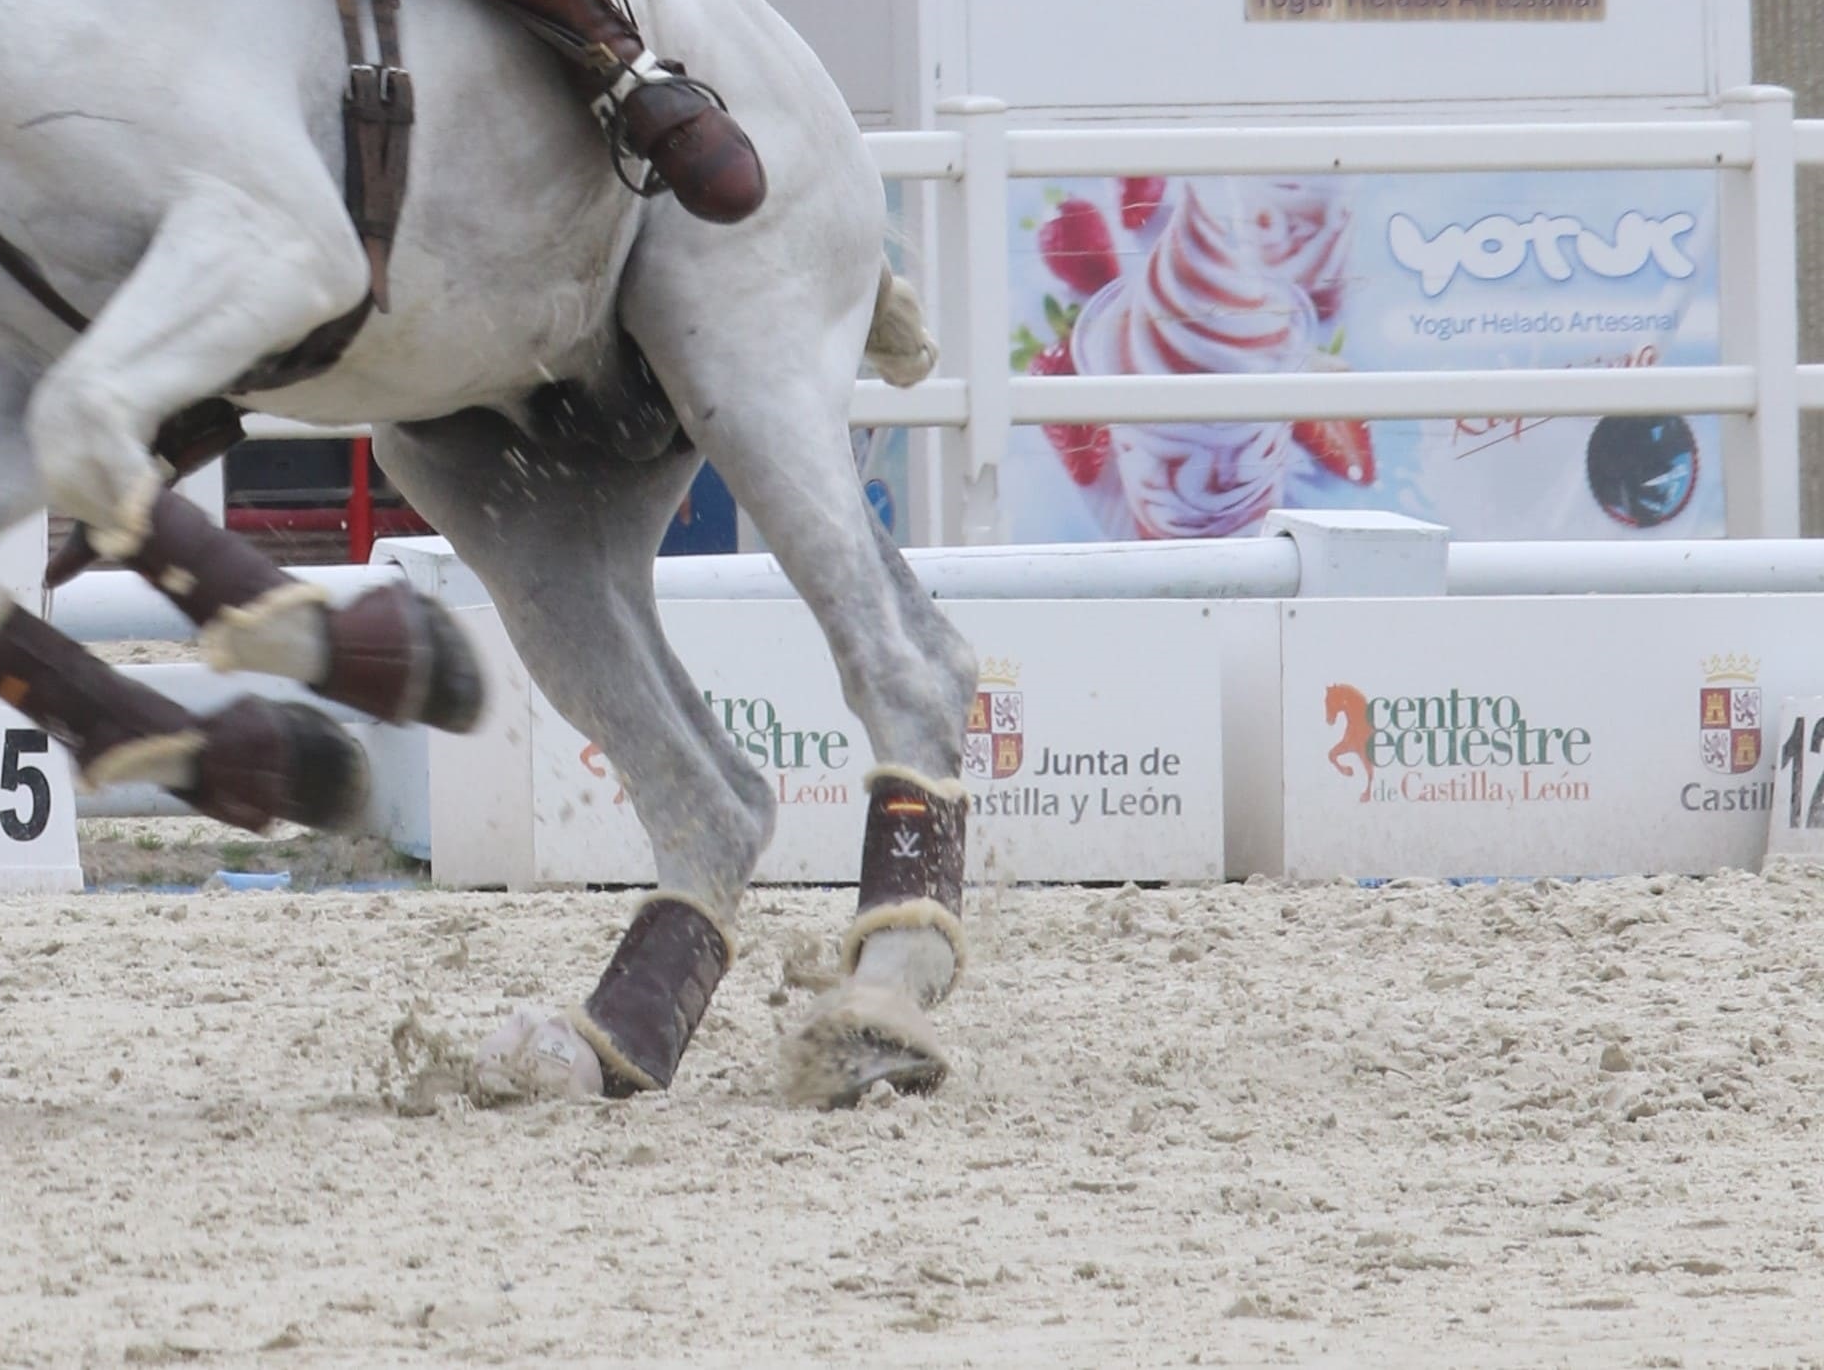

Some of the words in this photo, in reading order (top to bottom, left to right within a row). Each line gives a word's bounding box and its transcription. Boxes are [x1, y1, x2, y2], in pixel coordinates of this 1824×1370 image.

[1409, 313, 1477, 340] Yogur
[1481, 311, 1564, 333] Helado
[1570, 308, 1679, 332] Artesanal
[1366, 688, 1521, 731] centro
[1366, 719, 1592, 768] ecuestre
[1034, 747, 1128, 776] Junta
[1139, 747, 1181, 776] de
[777, 774, 849, 805] León
[970, 787, 1060, 816] astilla
[1069, 793, 1089, 825] y
[1100, 787, 1182, 816] León
[1372, 780, 1399, 803] de
[1400, 770, 1505, 803] Castilla
[1505, 788, 1517, 811] y
[1520, 770, 1591, 802] León
[1680, 781, 1776, 812] Castill
